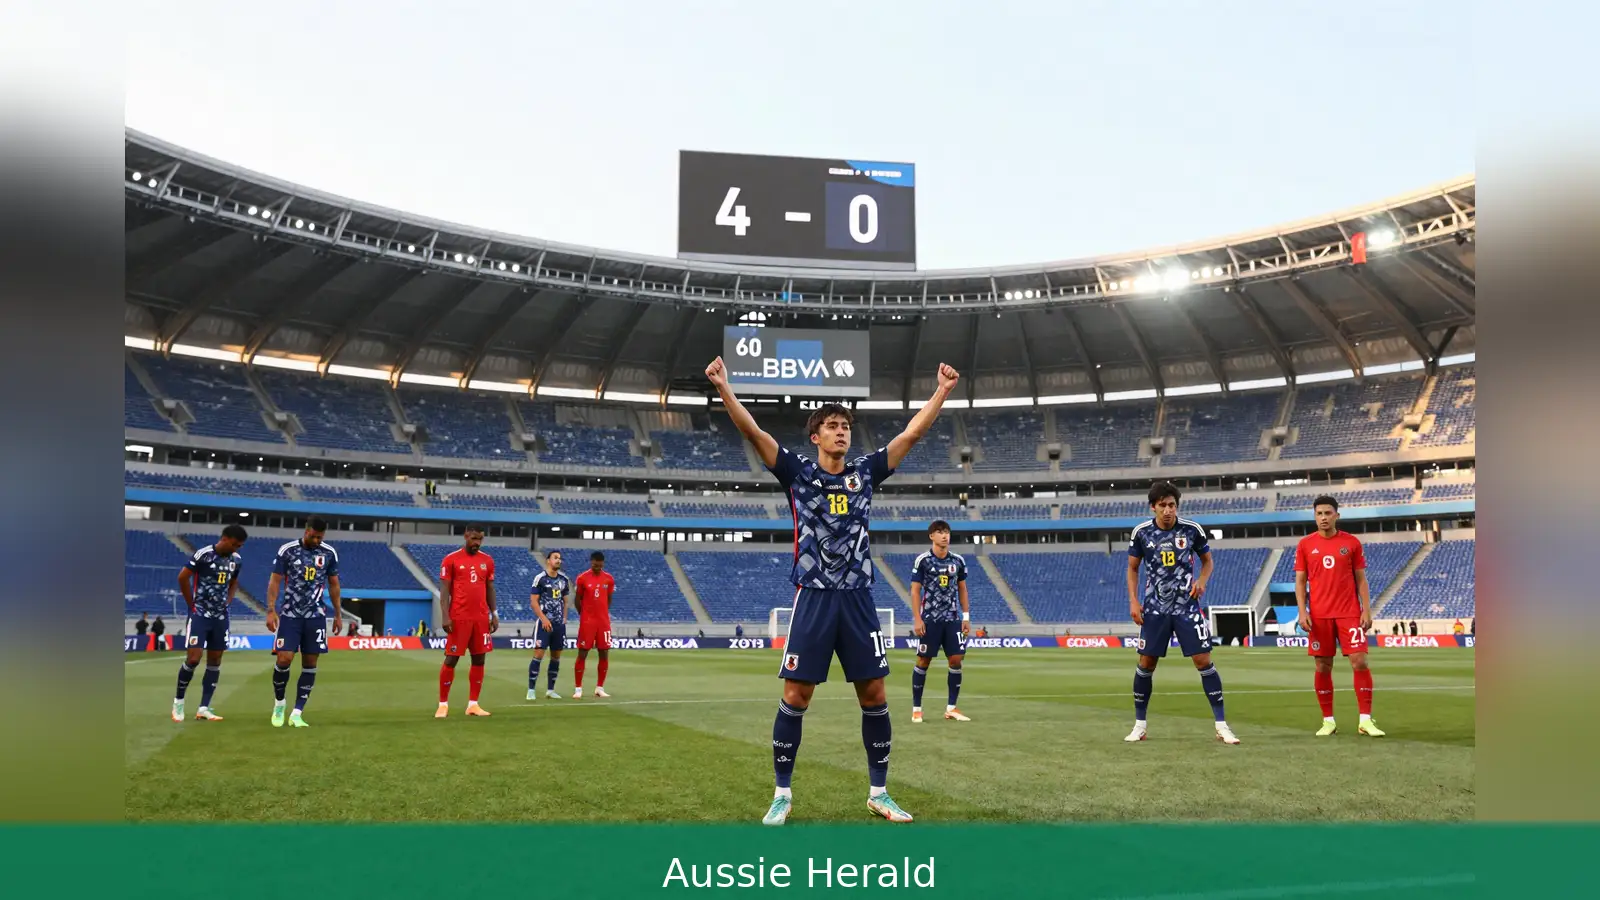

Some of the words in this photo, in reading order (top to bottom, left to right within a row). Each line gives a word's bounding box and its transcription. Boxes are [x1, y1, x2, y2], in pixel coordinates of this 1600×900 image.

[715, 187, 751, 236] 4
[849, 194, 879, 243] 0
[736, 337, 762, 357] 60
[763, 358, 830, 379] BBVA
